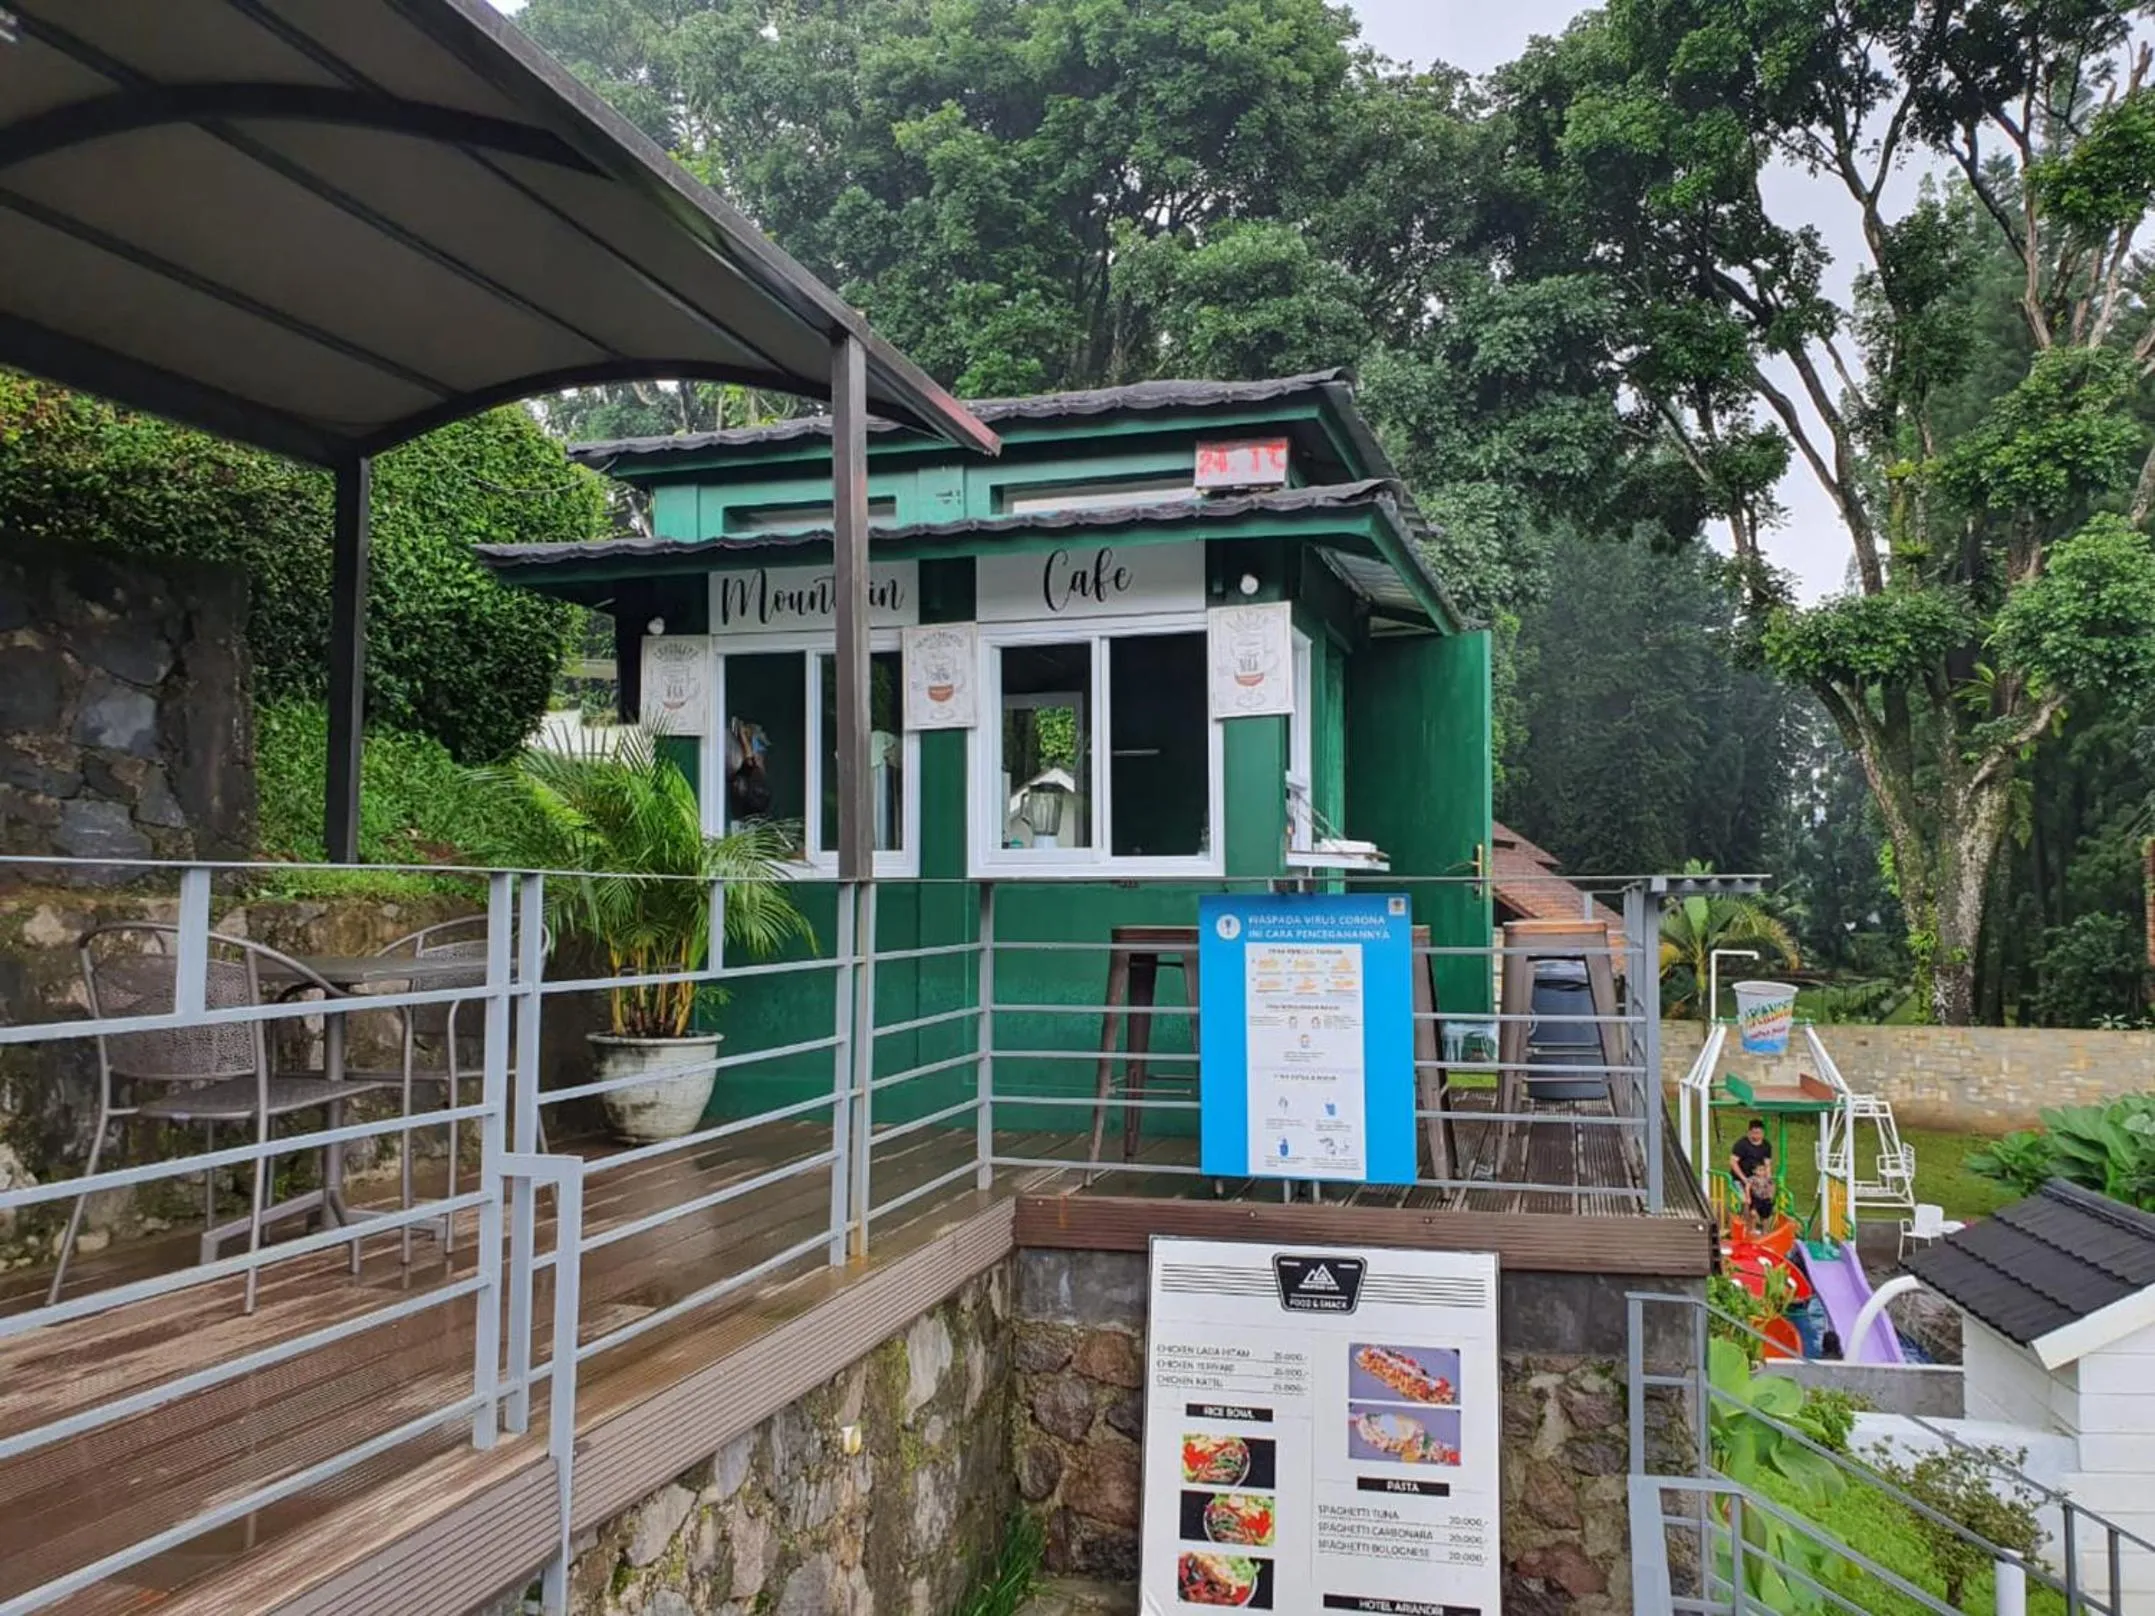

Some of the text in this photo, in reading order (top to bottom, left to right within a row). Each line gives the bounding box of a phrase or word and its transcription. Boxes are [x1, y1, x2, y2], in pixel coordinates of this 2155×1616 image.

[721, 546, 1133, 625] Mountin Cafe
[1248, 915, 1385, 925] WASPADA VIRUS CORONA
[1265, 929, 1293, 938] CARA
[1156, 1343, 1194, 1354] CHICKEN
[1156, 1359, 1194, 1369] CHICKEN
[1203, 1406, 1255, 1419] RICE BOWL
[1386, 1480, 1420, 1492] PASTA
[1318, 1504, 1370, 1517] SPAGHETTI
[1372, 1509, 1400, 1520] TUNA
[1318, 1521, 1370, 1535] SPAGHETTI
[1371, 1526, 1434, 1540] CARBONARA
[1318, 1539, 1370, 1552] SPAGHETTI
[1371, 1544, 1429, 1557] BOLOGNESE
[1358, 1600, 1392, 1612] HOTEL
